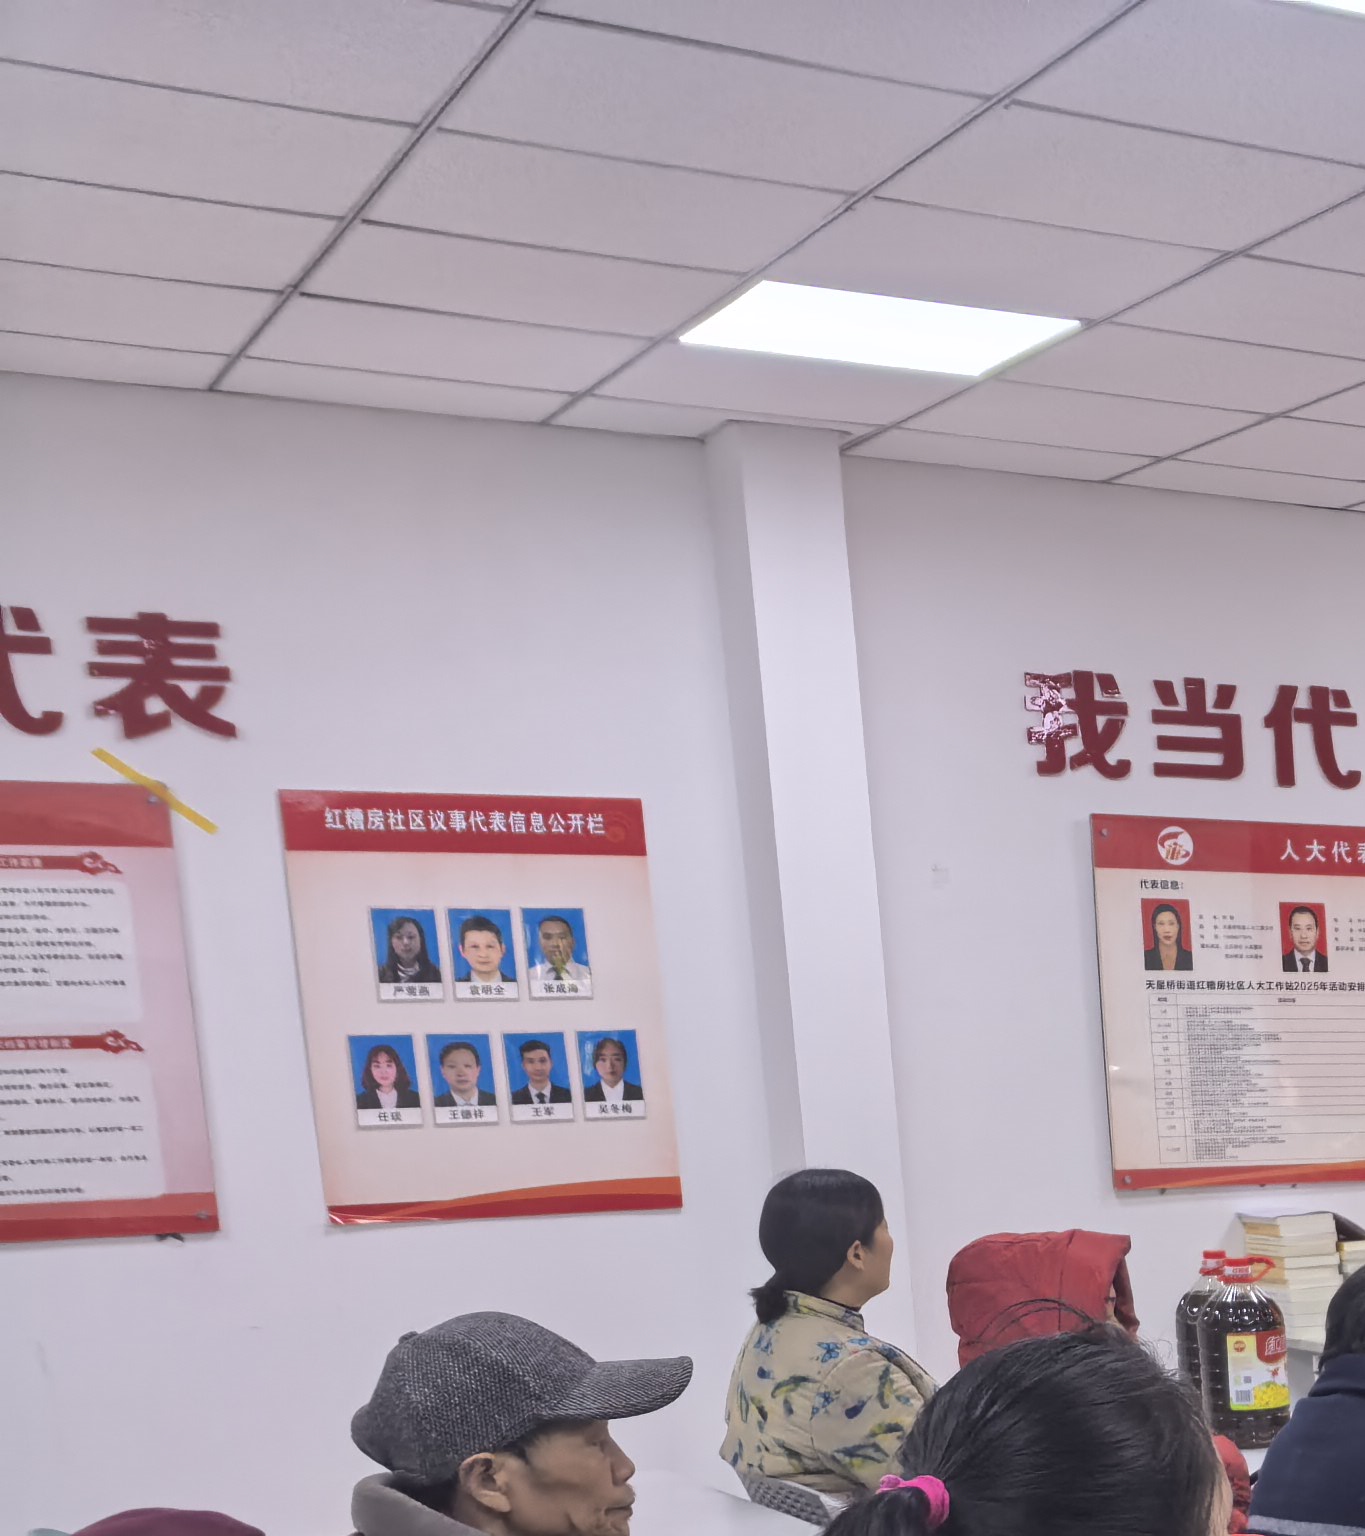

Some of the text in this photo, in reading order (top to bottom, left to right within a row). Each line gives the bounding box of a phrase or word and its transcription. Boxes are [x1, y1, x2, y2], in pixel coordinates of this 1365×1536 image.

[324, 807, 605, 834] 红糟房社区议事代表信息公开栏
